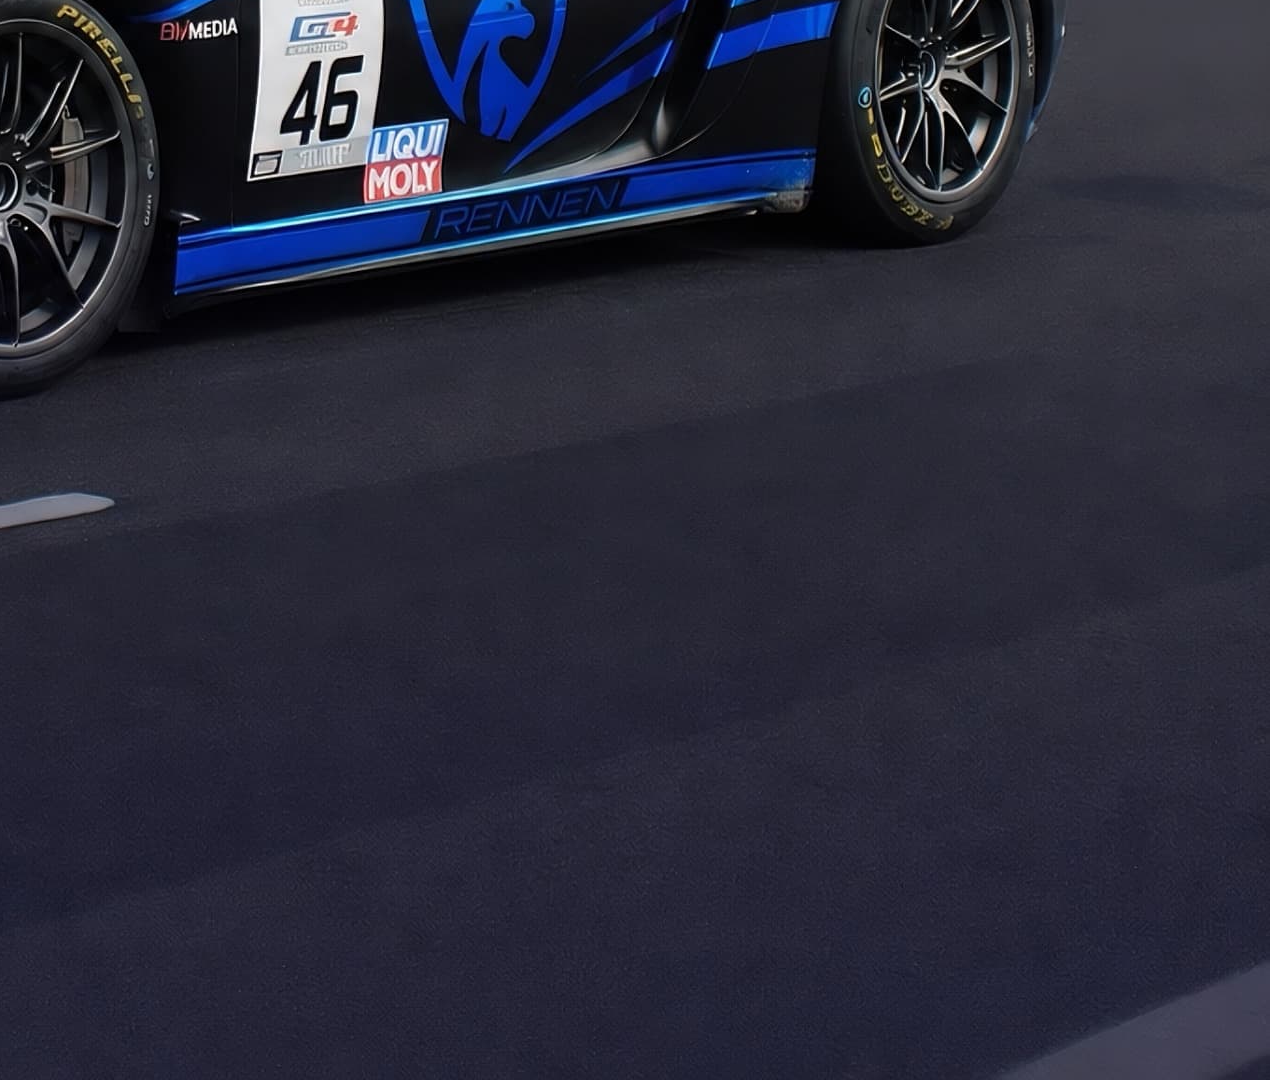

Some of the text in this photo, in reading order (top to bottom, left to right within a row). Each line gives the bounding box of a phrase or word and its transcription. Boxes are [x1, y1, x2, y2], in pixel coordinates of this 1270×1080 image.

[280, 55, 364, 146] 46
[371, 123, 444, 163] LIQUI
[367, 159, 438, 201] MOLY
[434, 180, 620, 240] RENNEN
